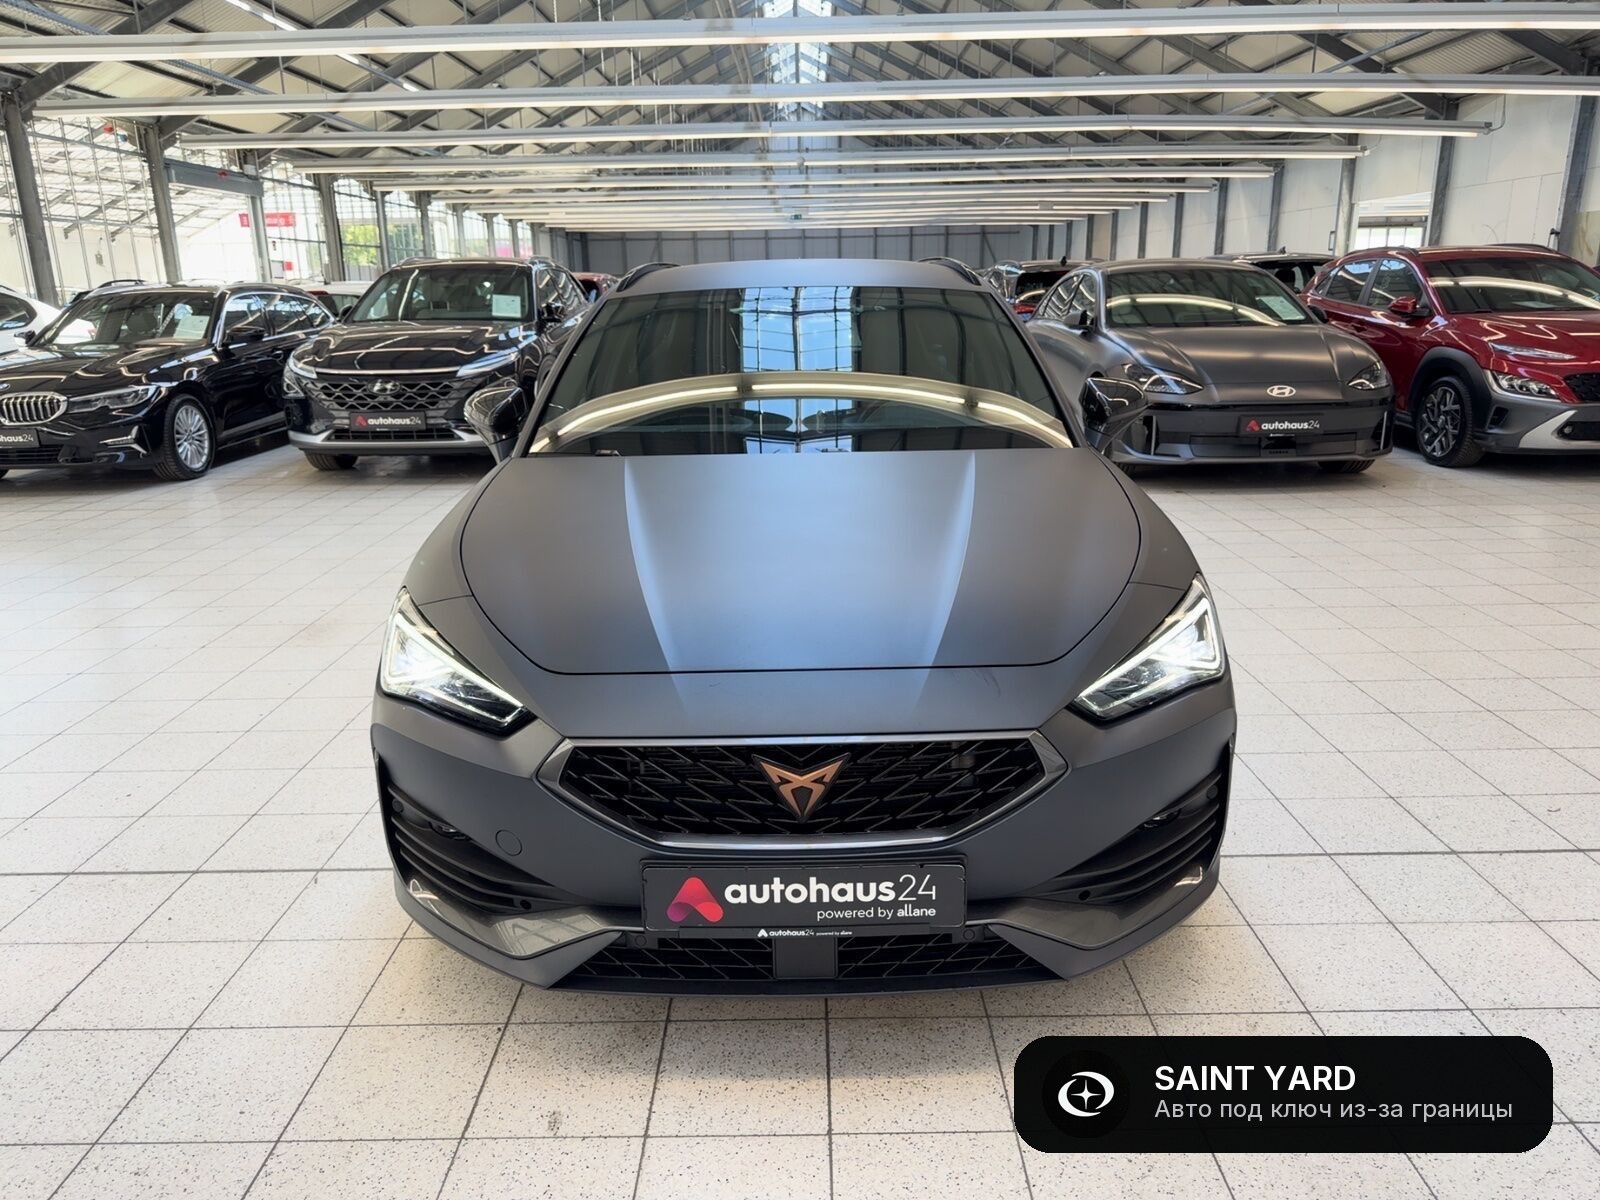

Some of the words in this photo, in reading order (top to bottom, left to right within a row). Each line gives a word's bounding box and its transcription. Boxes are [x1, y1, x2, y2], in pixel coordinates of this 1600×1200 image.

[367, 416, 422, 425] autohaus24
[1261, 420, 1320, 430] autohaus24
[0, 433, 34, 442] haus24
[724, 874, 937, 904] autohaus24
[816, 907, 875, 922] powered
[877, 906, 894, 920] by
[896, 903, 937, 918] allane
[769, 929, 815, 937] autohaus24
